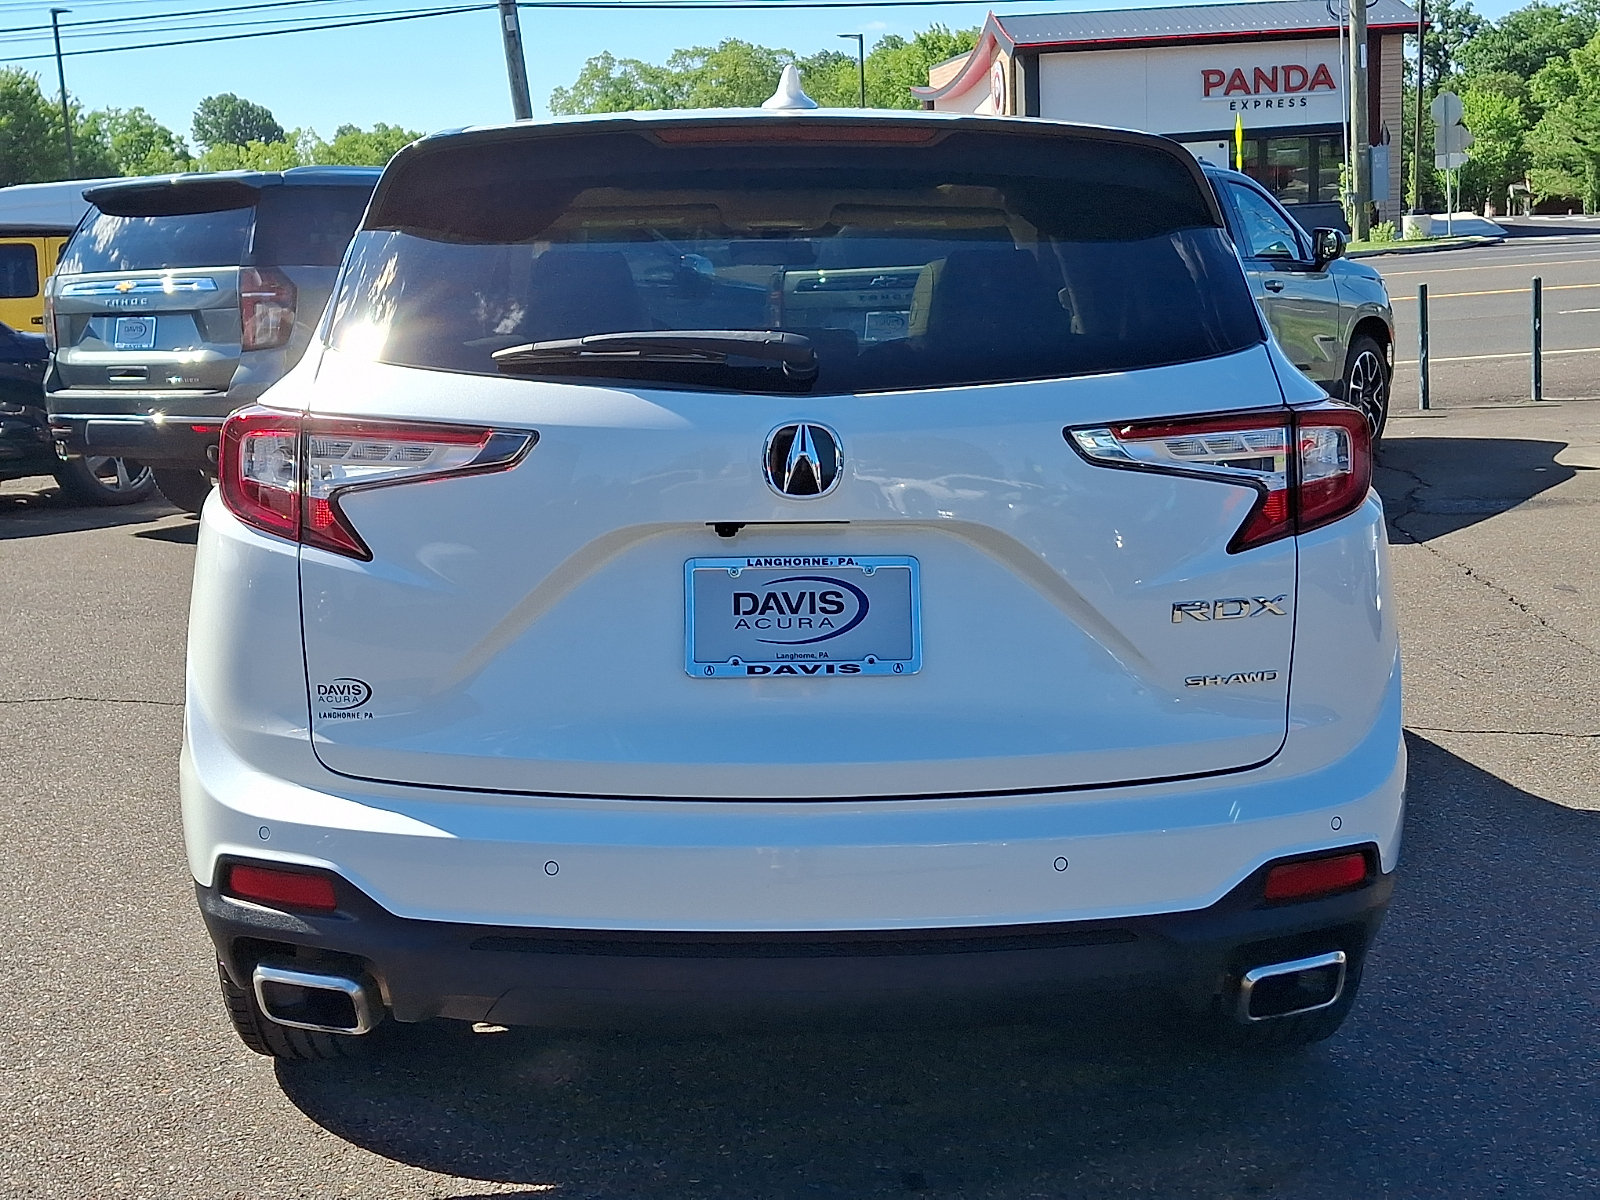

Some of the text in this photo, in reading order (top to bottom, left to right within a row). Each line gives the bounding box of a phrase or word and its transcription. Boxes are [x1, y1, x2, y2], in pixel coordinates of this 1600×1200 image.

[1201, 63, 1336, 96] PANDA
[1229, 97, 1307, 111] EXPRESS
[104, 297, 148, 306] TAHOE
[746, 558, 859, 567] LANGHORNE, PA.
[733, 590, 846, 616] DAVIS
[1171, 594, 1287, 623] RDX
[734, 617, 835, 630] ACURA
[818, 651, 829, 659] PA
[746, 663, 861, 675] DAVIS
[317, 684, 362, 695] DAVIS
[318, 695, 359, 703] ACURA
[364, 711, 374, 719] PA
